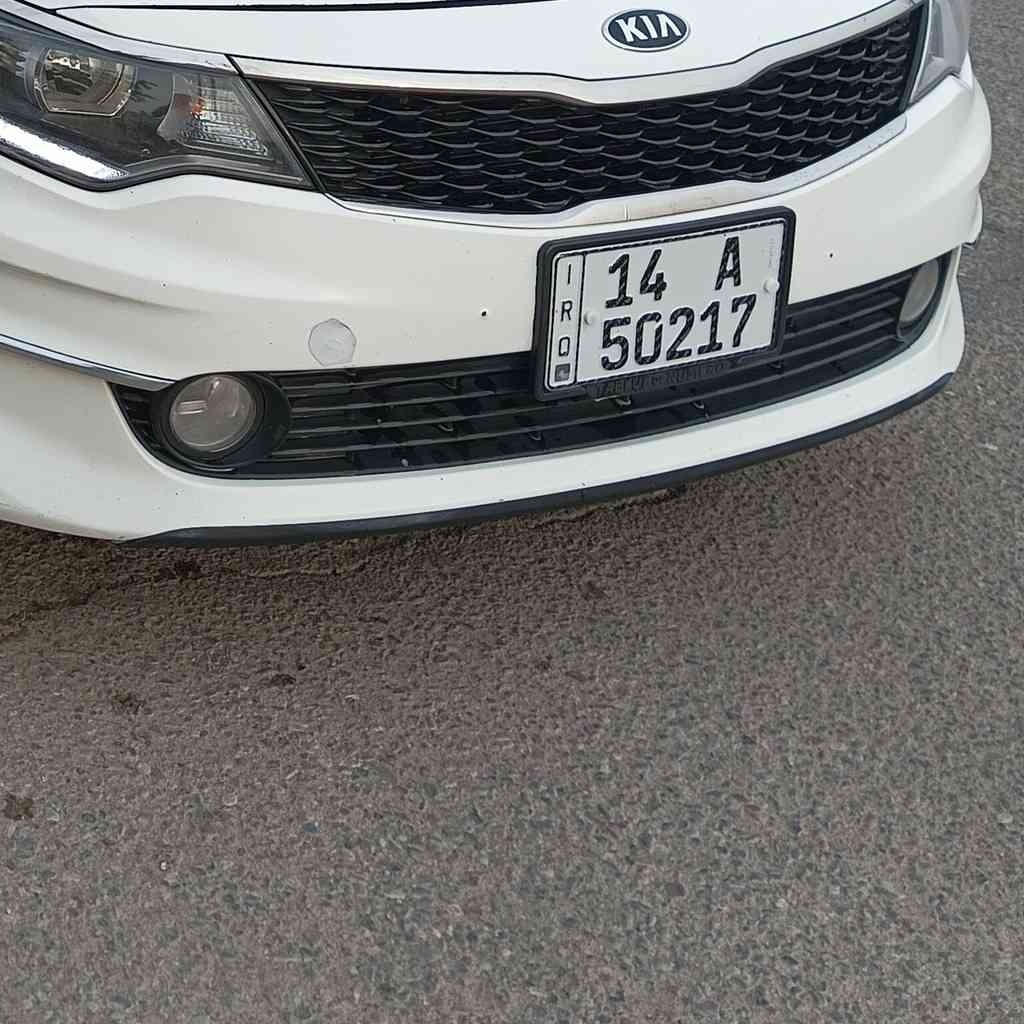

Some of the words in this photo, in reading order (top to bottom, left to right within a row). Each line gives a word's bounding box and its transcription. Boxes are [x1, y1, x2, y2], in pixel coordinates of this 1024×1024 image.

[615, 13, 682, 42] KIA
[558, 262, 574, 358] IRQ
[605, 248, 668, 309] 14
[714, 236, 742, 291] A
[600, 293, 758, 371] 50217
